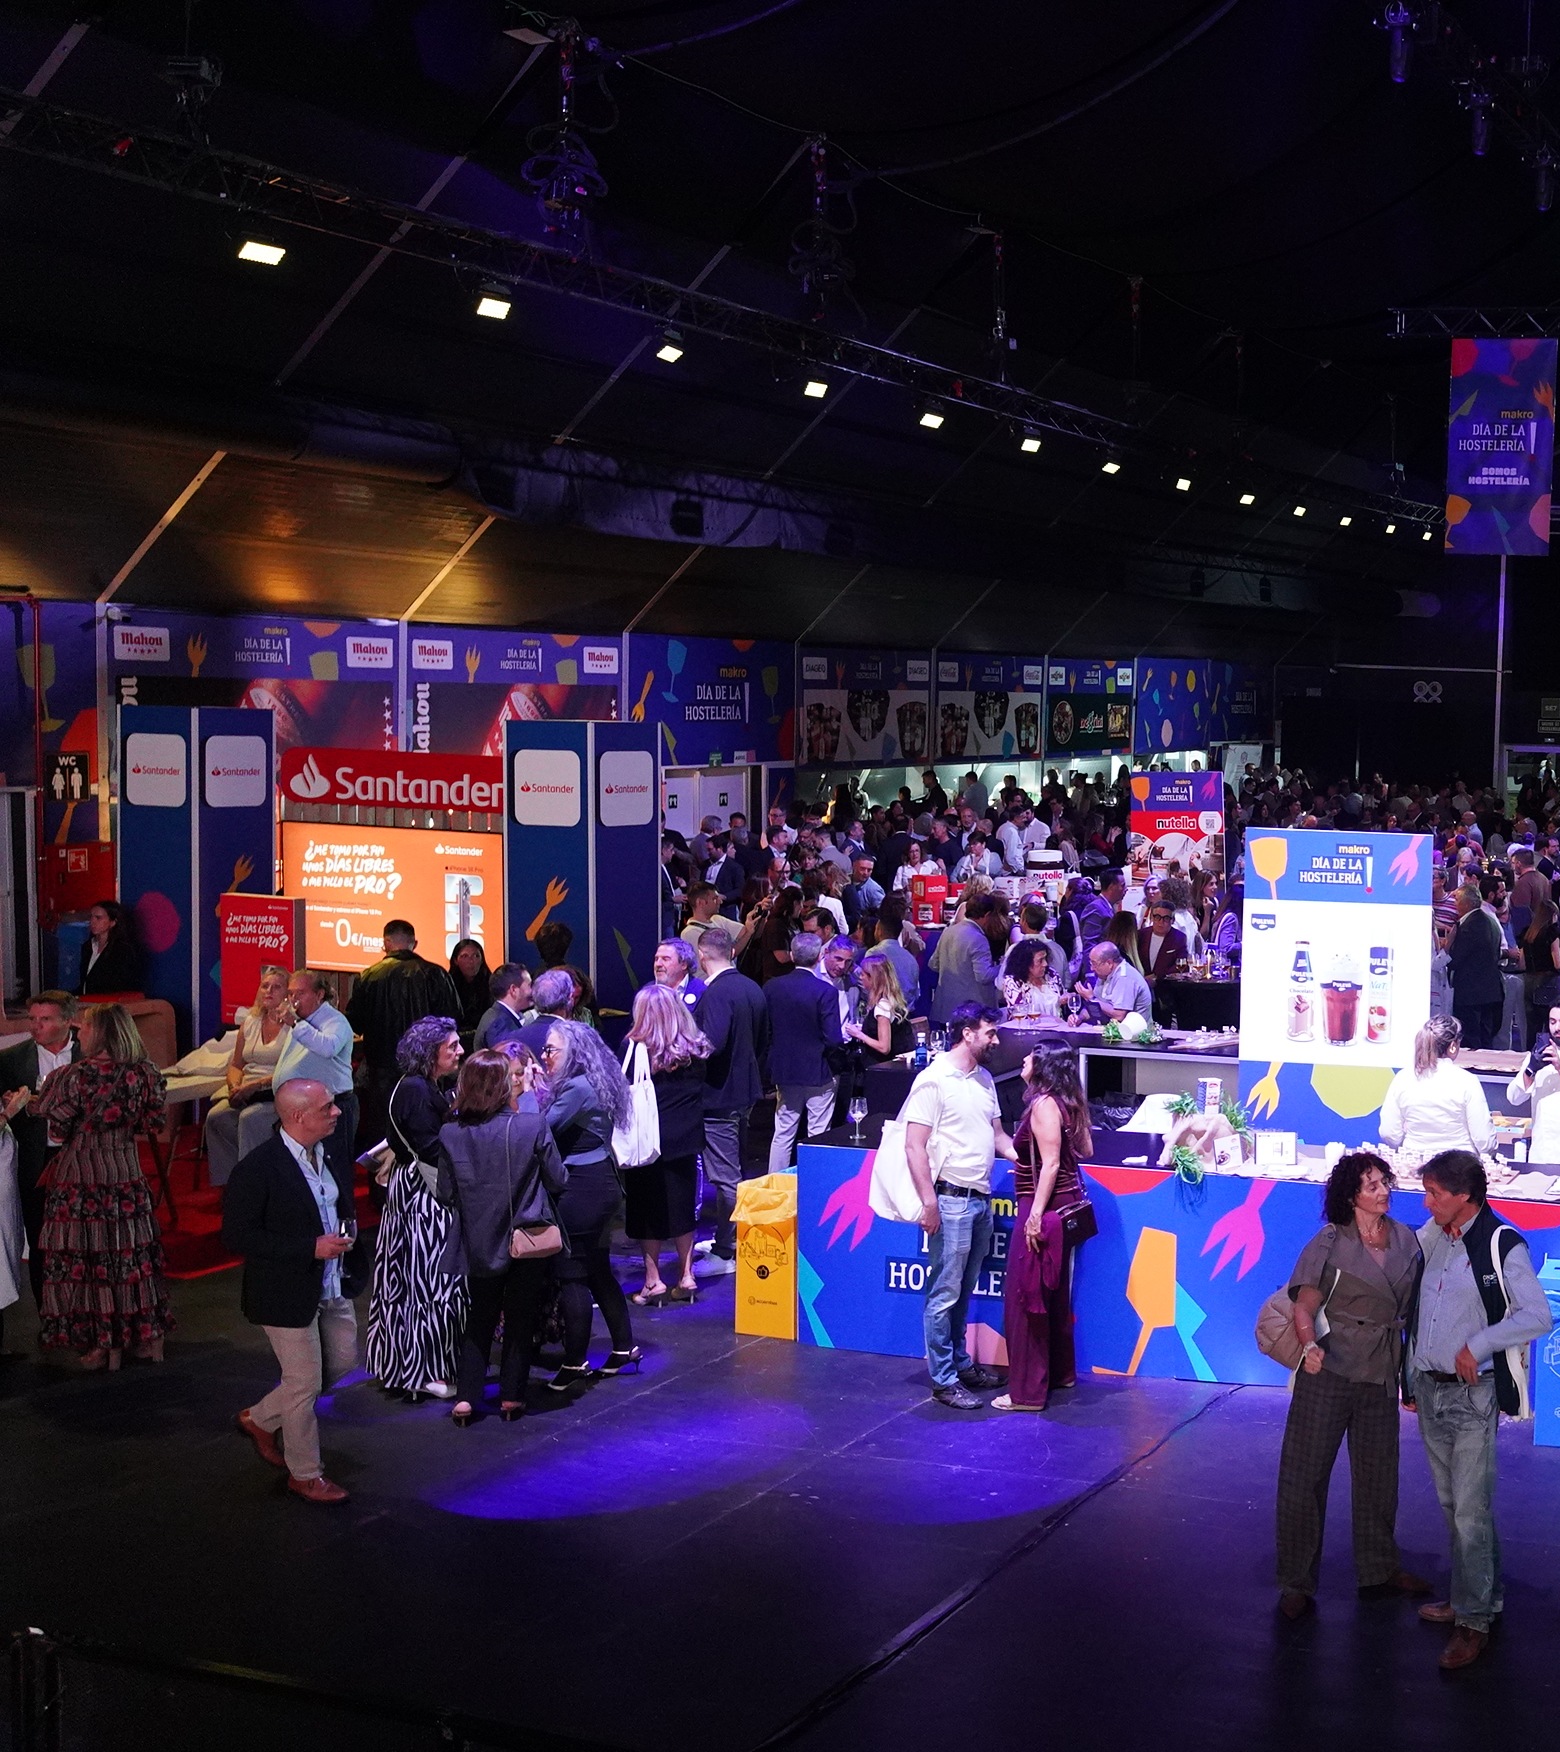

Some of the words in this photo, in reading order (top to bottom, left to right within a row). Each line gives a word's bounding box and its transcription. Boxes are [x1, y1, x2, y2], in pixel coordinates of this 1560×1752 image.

[1501, 410, 1534, 419] makro
[1472, 423, 1491, 436] DÍA
[1494, 424, 1508, 436] DE
[1511, 424, 1525, 436] LA
[1459, 439, 1525, 452] HOSTELERÍA
[1481, 467, 1517, 476] SOMOS
[1468, 475, 1530, 485] HOSTELERÍA
[120, 631, 163, 647] Mahou
[244, 636, 258, 650] DÍA
[259, 638, 270, 650] DE
[271, 638, 283, 651] LA
[352, 643, 388, 656] Mahou
[417, 645, 449, 658] Mahou
[234, 650, 284, 663] HOSTELERÍA
[587, 651, 615, 662] Mahou
[720, 666, 748, 678] makro
[696, 683, 713, 700] DÍA
[715, 685, 727, 700] DE
[729, 685, 741, 700] LA
[412, 682, 431, 754] ahou
[685, 704, 742, 721] HOSTELERÍA
[58, 756, 77, 766] WC
[142, 766, 181, 776] Santander
[222, 767, 261, 777] Santander
[335, 766, 503, 808] Santander
[531, 782, 575, 795] Santander
[614, 783, 649, 794] Santander
[1156, 816, 1197, 830] nutella
[444, 844, 484, 857] Santander
[1338, 845, 1370, 855] makro
[325, 855, 352, 873] DÍAS
[354, 857, 395, 874] LIBRES
[1312, 855, 1331, 869] DÍA
[1332, 858, 1347, 870] DE
[1348, 858, 1363, 871] LA
[1299, 871, 1363, 885] HOSTELERÍA
[354, 872, 402, 900] PRO?
[1251, 917, 1276, 926] PULEVA
[240, 922, 257, 934] DÍAS
[258, 924, 284, 935] LIBRES
